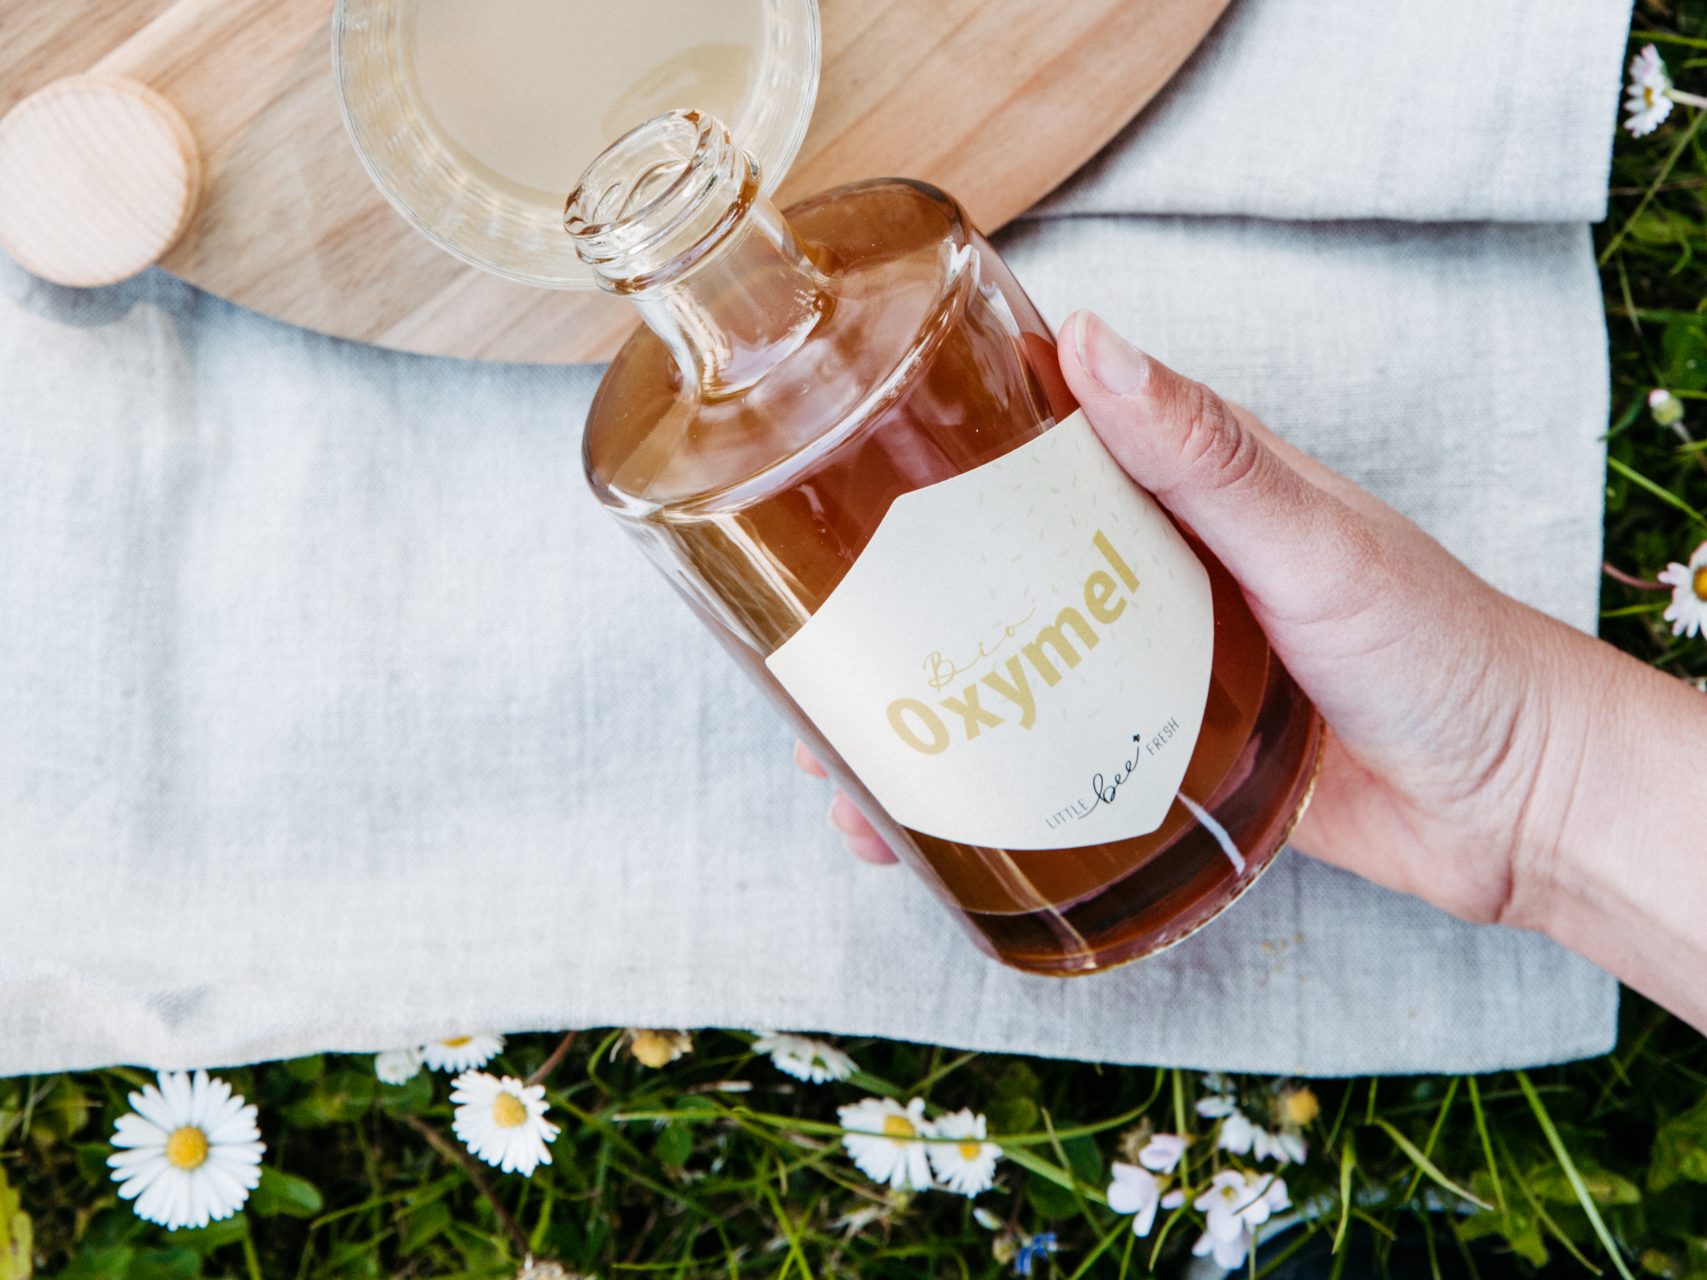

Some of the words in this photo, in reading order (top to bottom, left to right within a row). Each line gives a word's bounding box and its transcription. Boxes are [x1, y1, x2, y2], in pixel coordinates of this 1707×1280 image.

[886, 528, 1140, 756] Oxymel
[922, 607, 1036, 693] Bio
[1044, 799, 1089, 830] LITTLE
[1078, 746, 1139, 820] bee
[1145, 717, 1180, 756] FRESH
